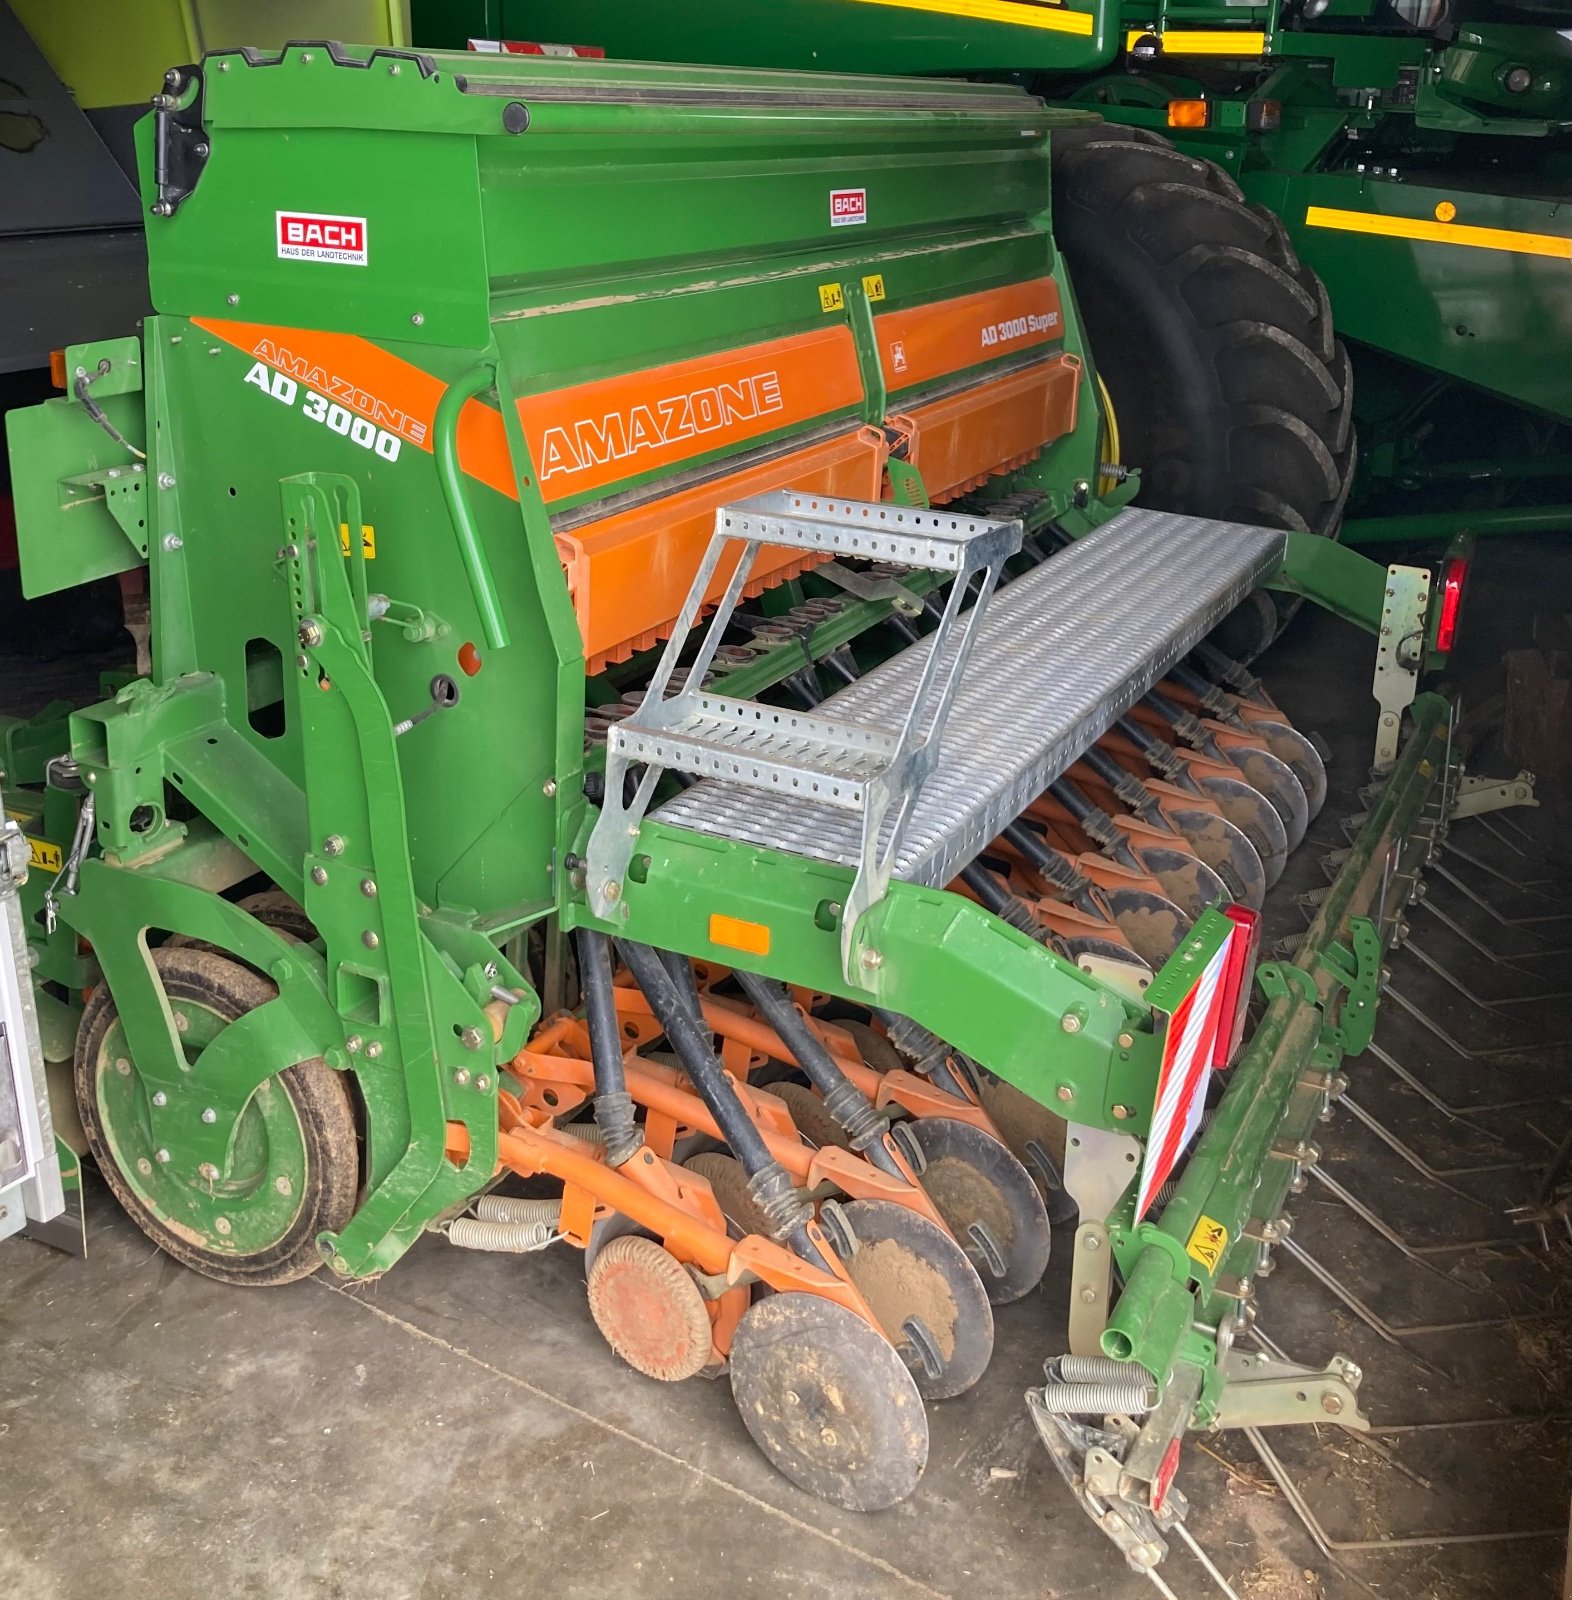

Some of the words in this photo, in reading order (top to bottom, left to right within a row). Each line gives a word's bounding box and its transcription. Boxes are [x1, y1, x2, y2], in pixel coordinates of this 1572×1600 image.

[834, 196, 863, 213] BACH
[287, 222, 357, 247] BACH
[281, 247, 300, 256] HAUS
[301, 248, 315, 257] DER
[317, 250, 364, 262] LANDTECHNIK
[981, 325, 998, 347] AD
[998, 317, 1028, 341] 3000
[1027, 311, 1058, 333] Super
[253, 338, 427, 444] AMAZONE
[243, 361, 298, 406] AD
[302, 390, 402, 463] 3000
[540, 371, 783, 481] AMAZONE
